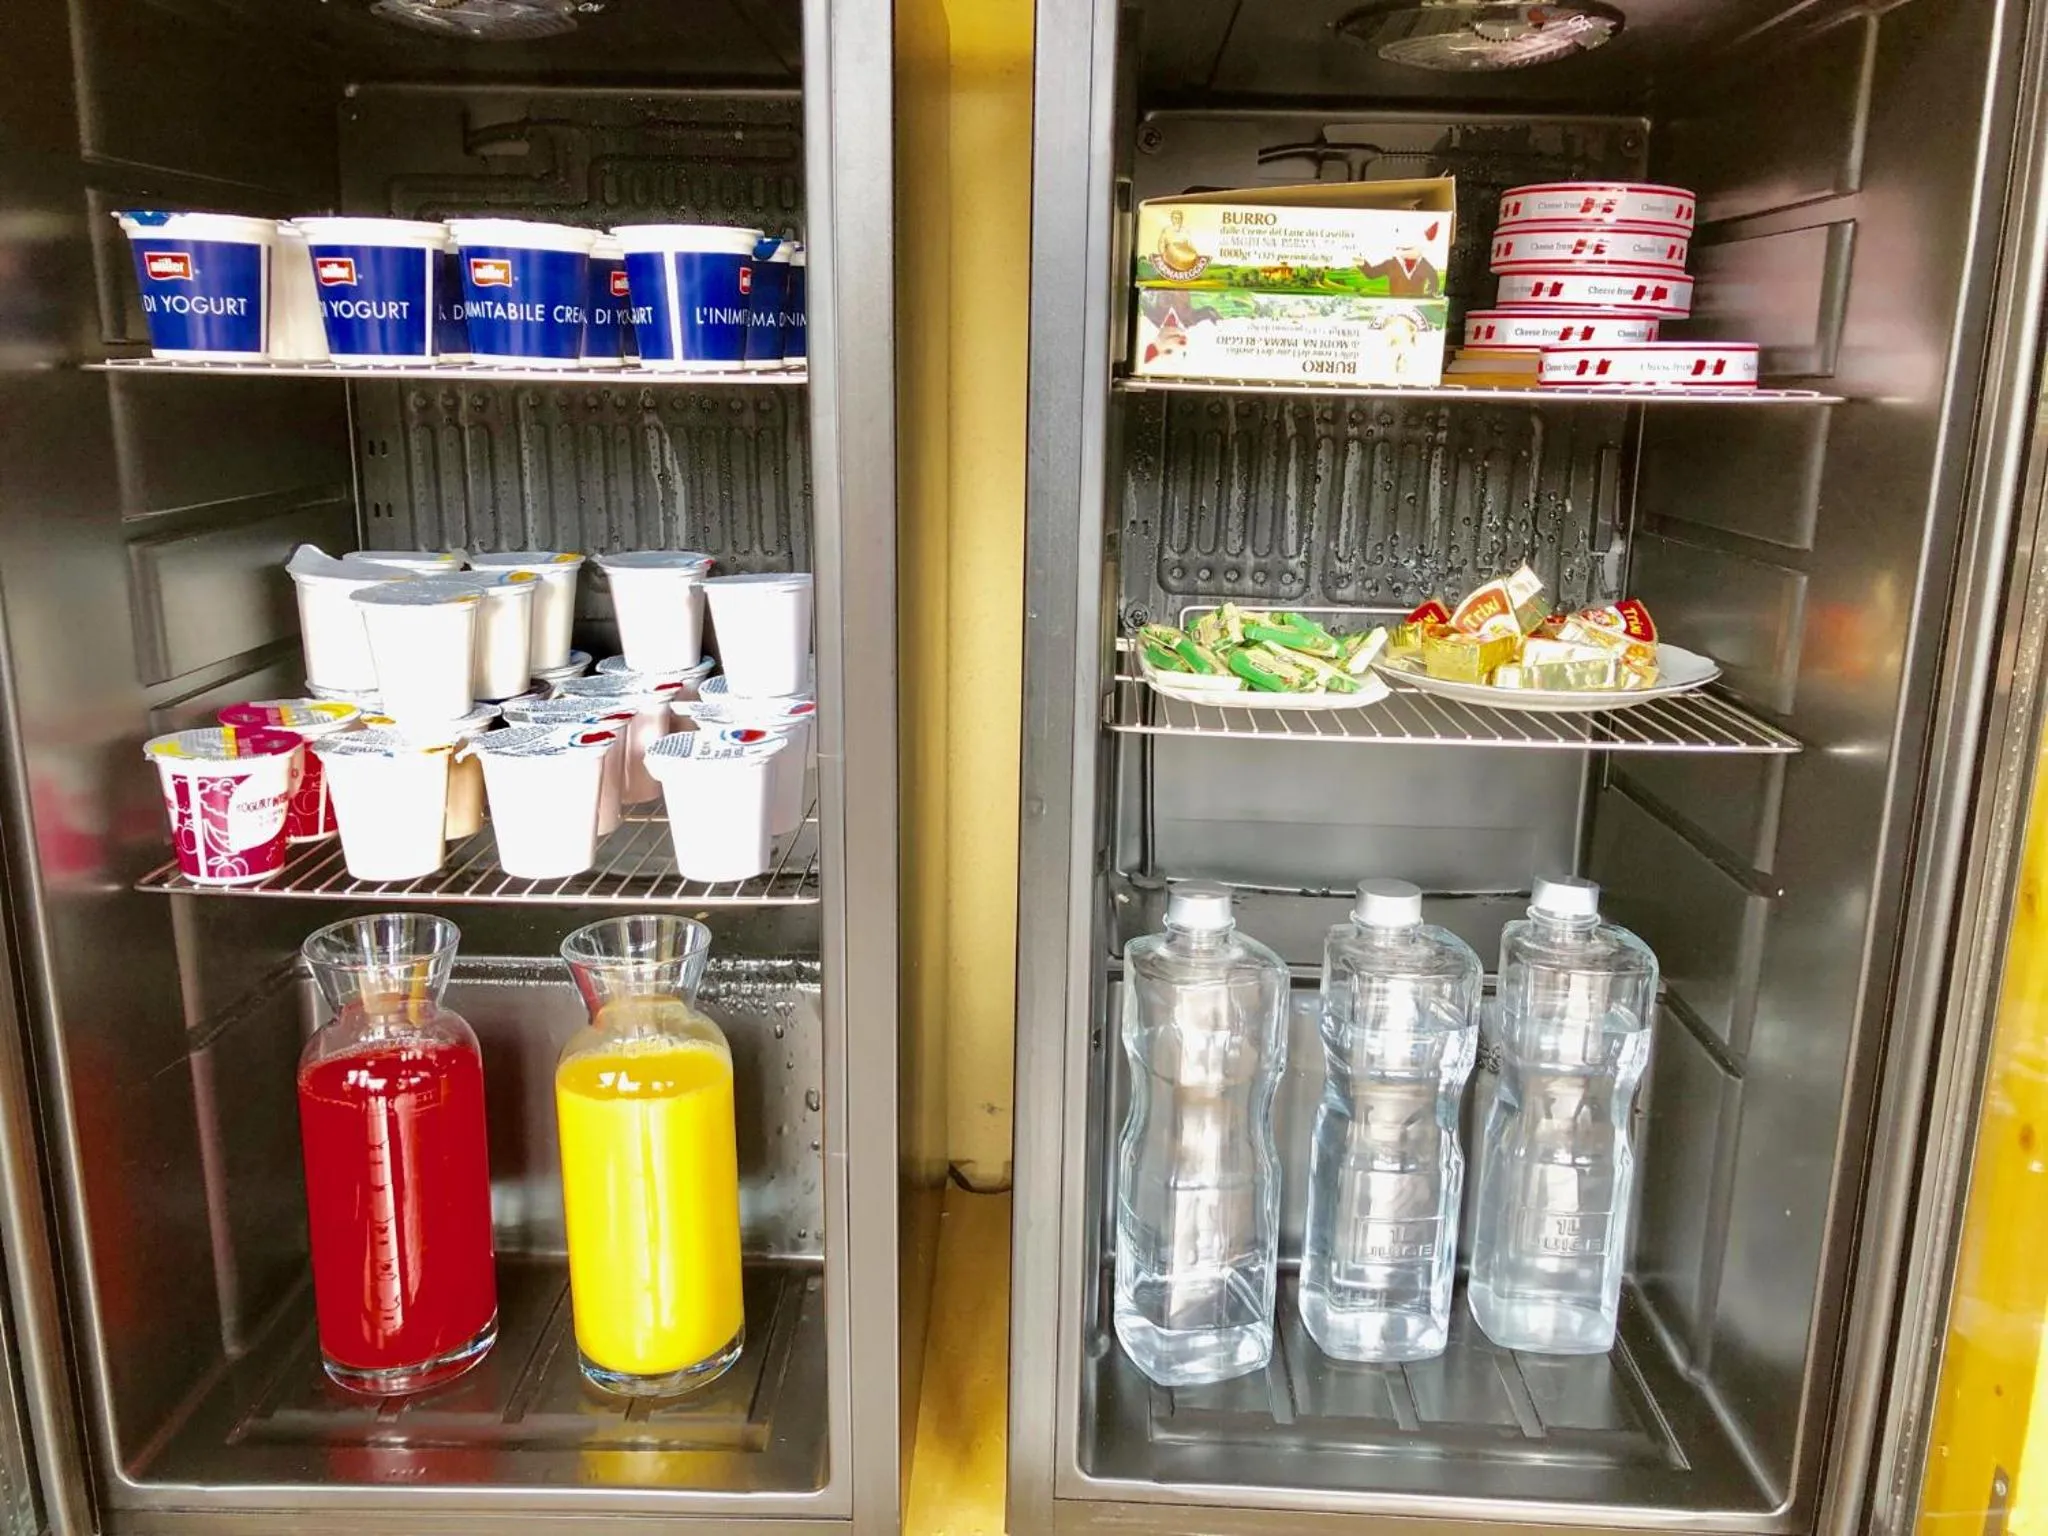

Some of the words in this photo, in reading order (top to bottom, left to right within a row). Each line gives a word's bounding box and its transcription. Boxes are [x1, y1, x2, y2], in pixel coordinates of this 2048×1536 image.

[1222, 211, 1277, 226] BURRO
[1587, 285, 1615, 296] Cheese
[160, 295, 247, 315] YOGURT
[329, 300, 410, 320] YOGURT
[1514, 327, 1540, 338] Cheese
[1302, 360, 1357, 375] BURRO
